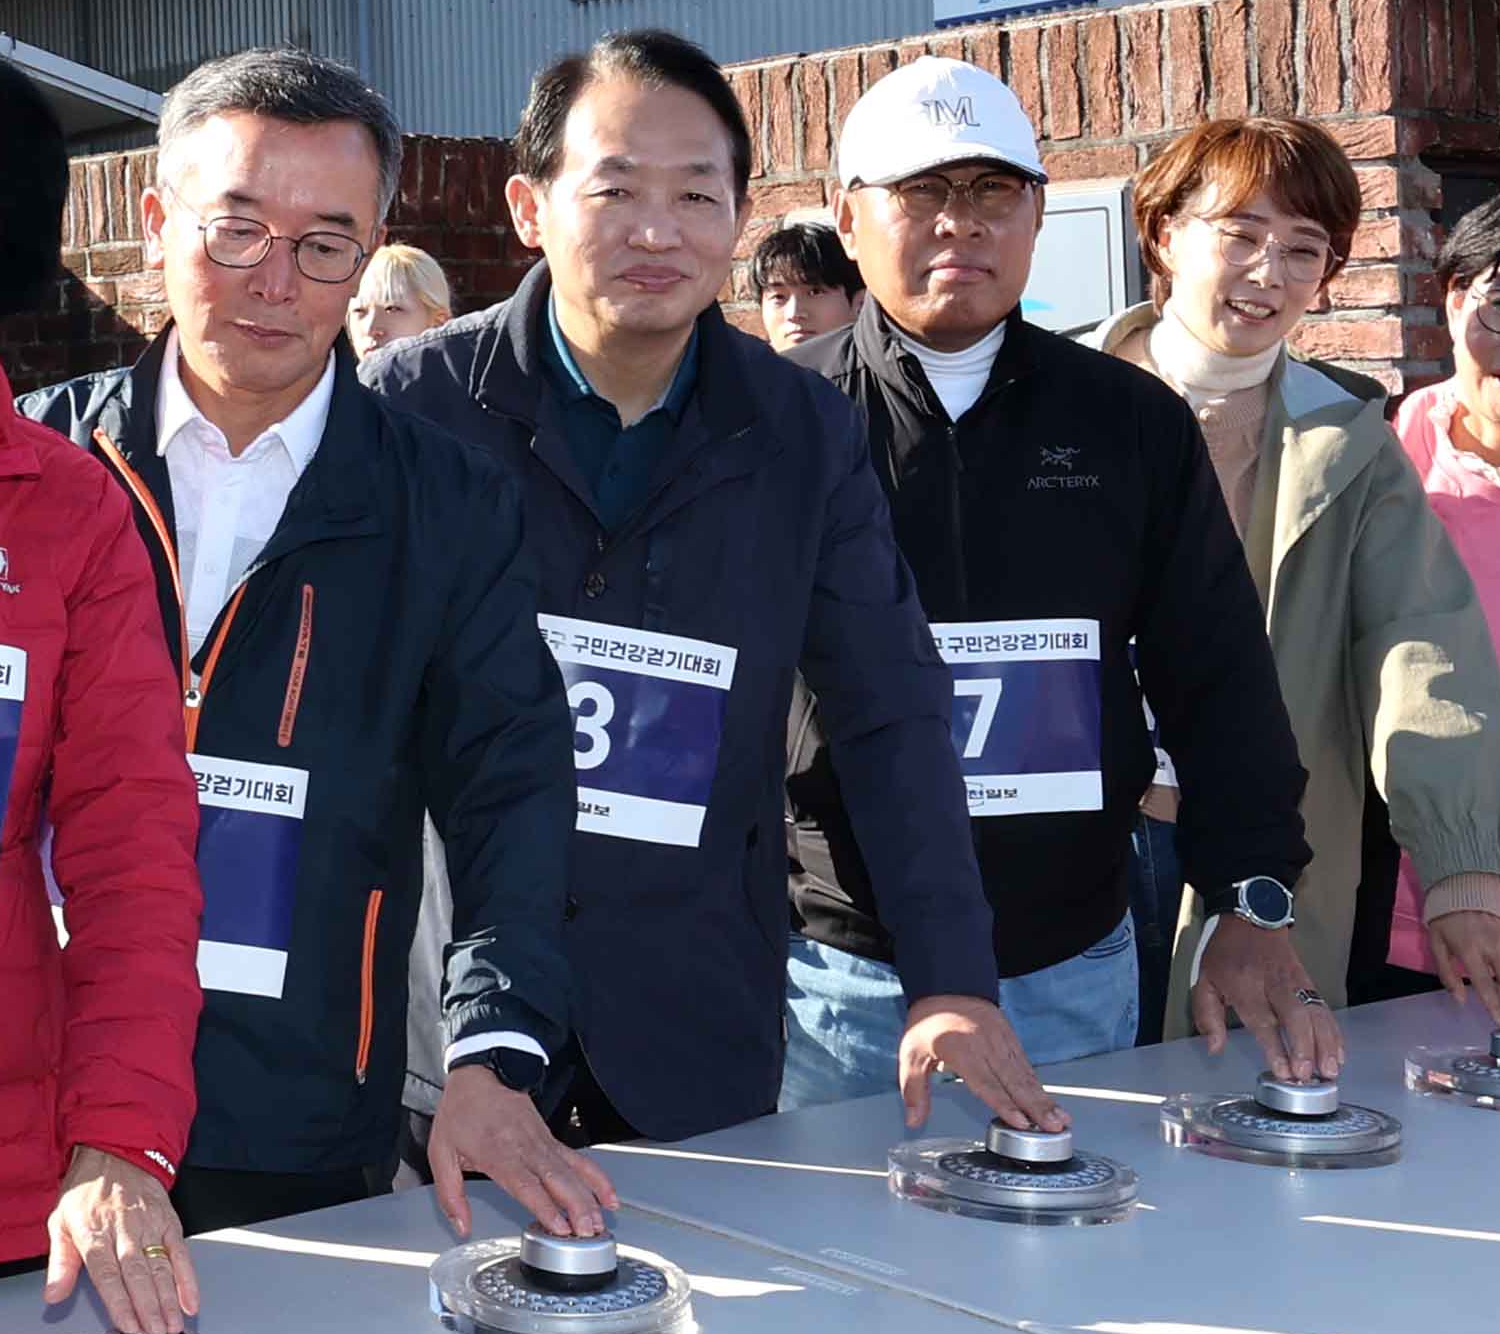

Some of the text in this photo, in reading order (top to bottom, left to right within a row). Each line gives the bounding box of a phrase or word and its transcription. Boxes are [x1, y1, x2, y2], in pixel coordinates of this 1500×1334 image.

[573, 634, 721, 677] 구민건강걷기대회
[948, 632, 1088, 655] 구민건강걷기대회
[566, 681, 615, 770] 3
[953, 677, 1003, 759] 7
